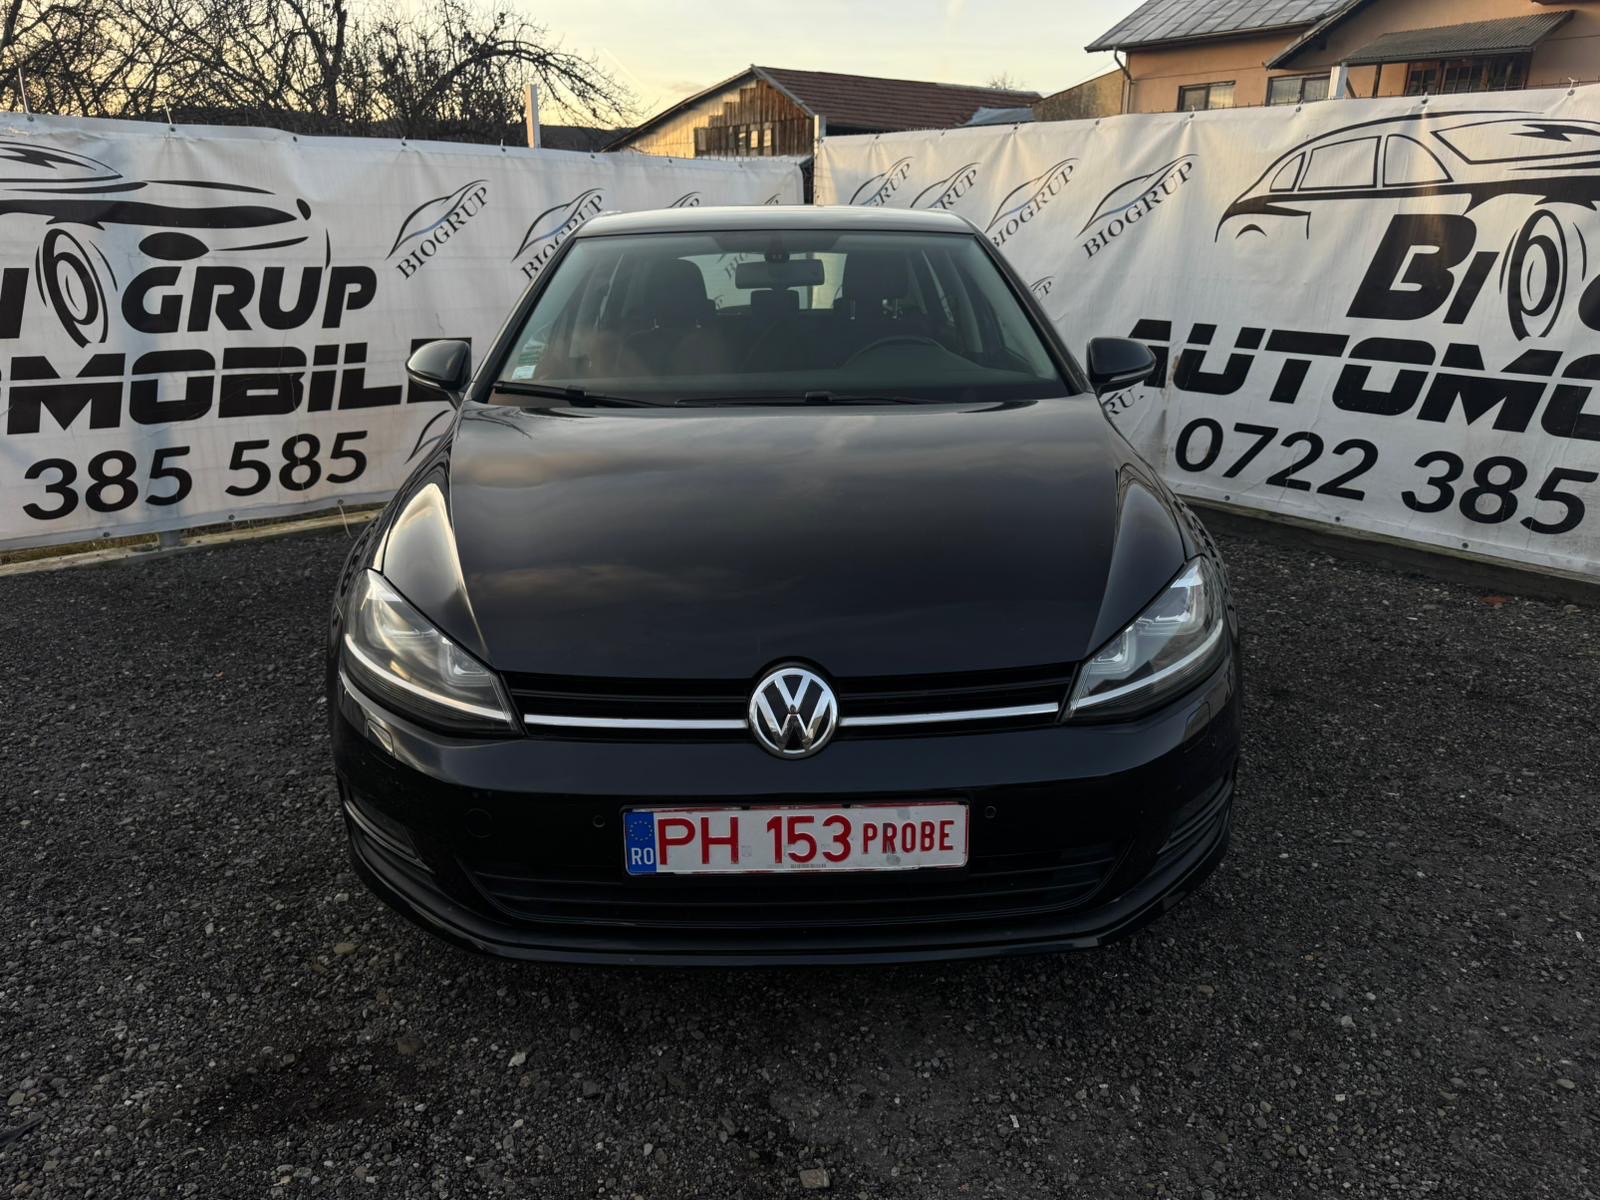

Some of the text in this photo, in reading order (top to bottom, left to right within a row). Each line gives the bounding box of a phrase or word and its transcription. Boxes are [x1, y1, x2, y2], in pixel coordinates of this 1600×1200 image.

[395, 186, 488, 281] BIOGRUP
[1081, 161, 1194, 260] BIOGRUP
[22, 430, 368, 520] 385 585
[1175, 417, 1599, 535] 0722 385
[631, 847, 655, 865] RO
[658, 815, 955, 866] PH 153 PROBE
